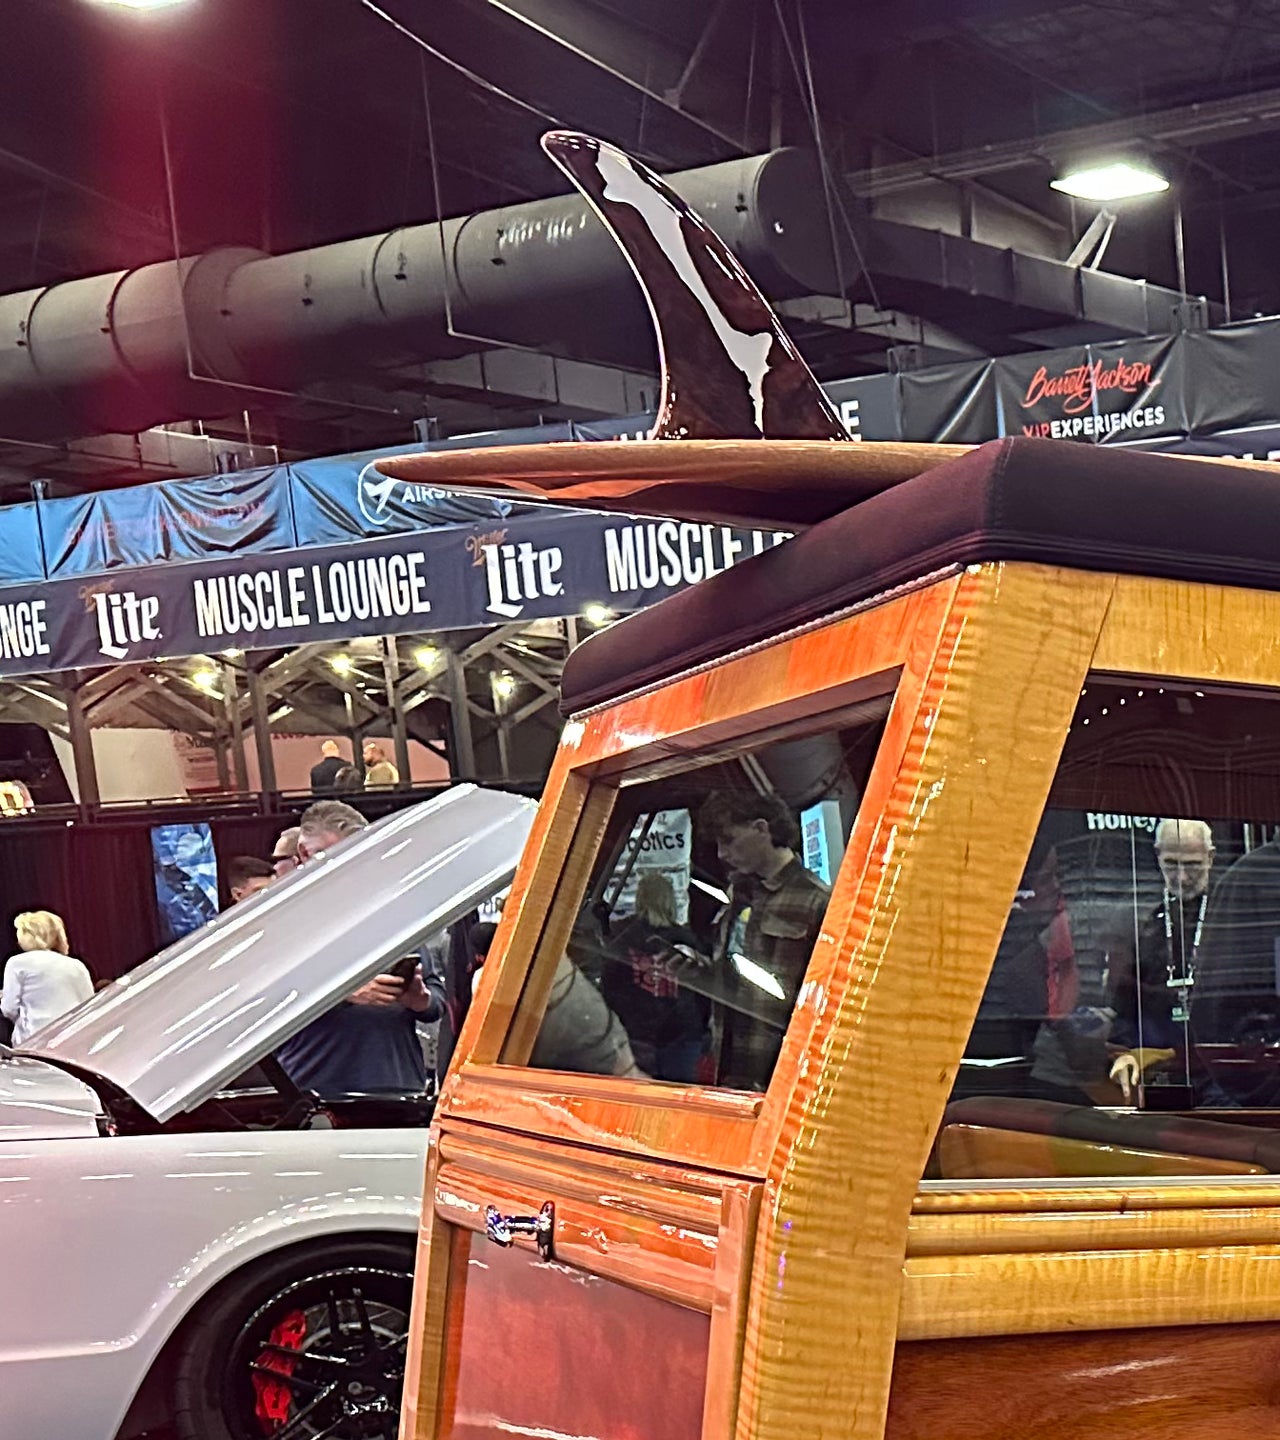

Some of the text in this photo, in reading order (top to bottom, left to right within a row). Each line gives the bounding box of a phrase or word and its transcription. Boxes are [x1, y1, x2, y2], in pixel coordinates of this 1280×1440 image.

[194, 566, 310, 637] MUSCLE
[315, 553, 431, 624] LOUNGE
[481, 542, 565, 618] Lite
